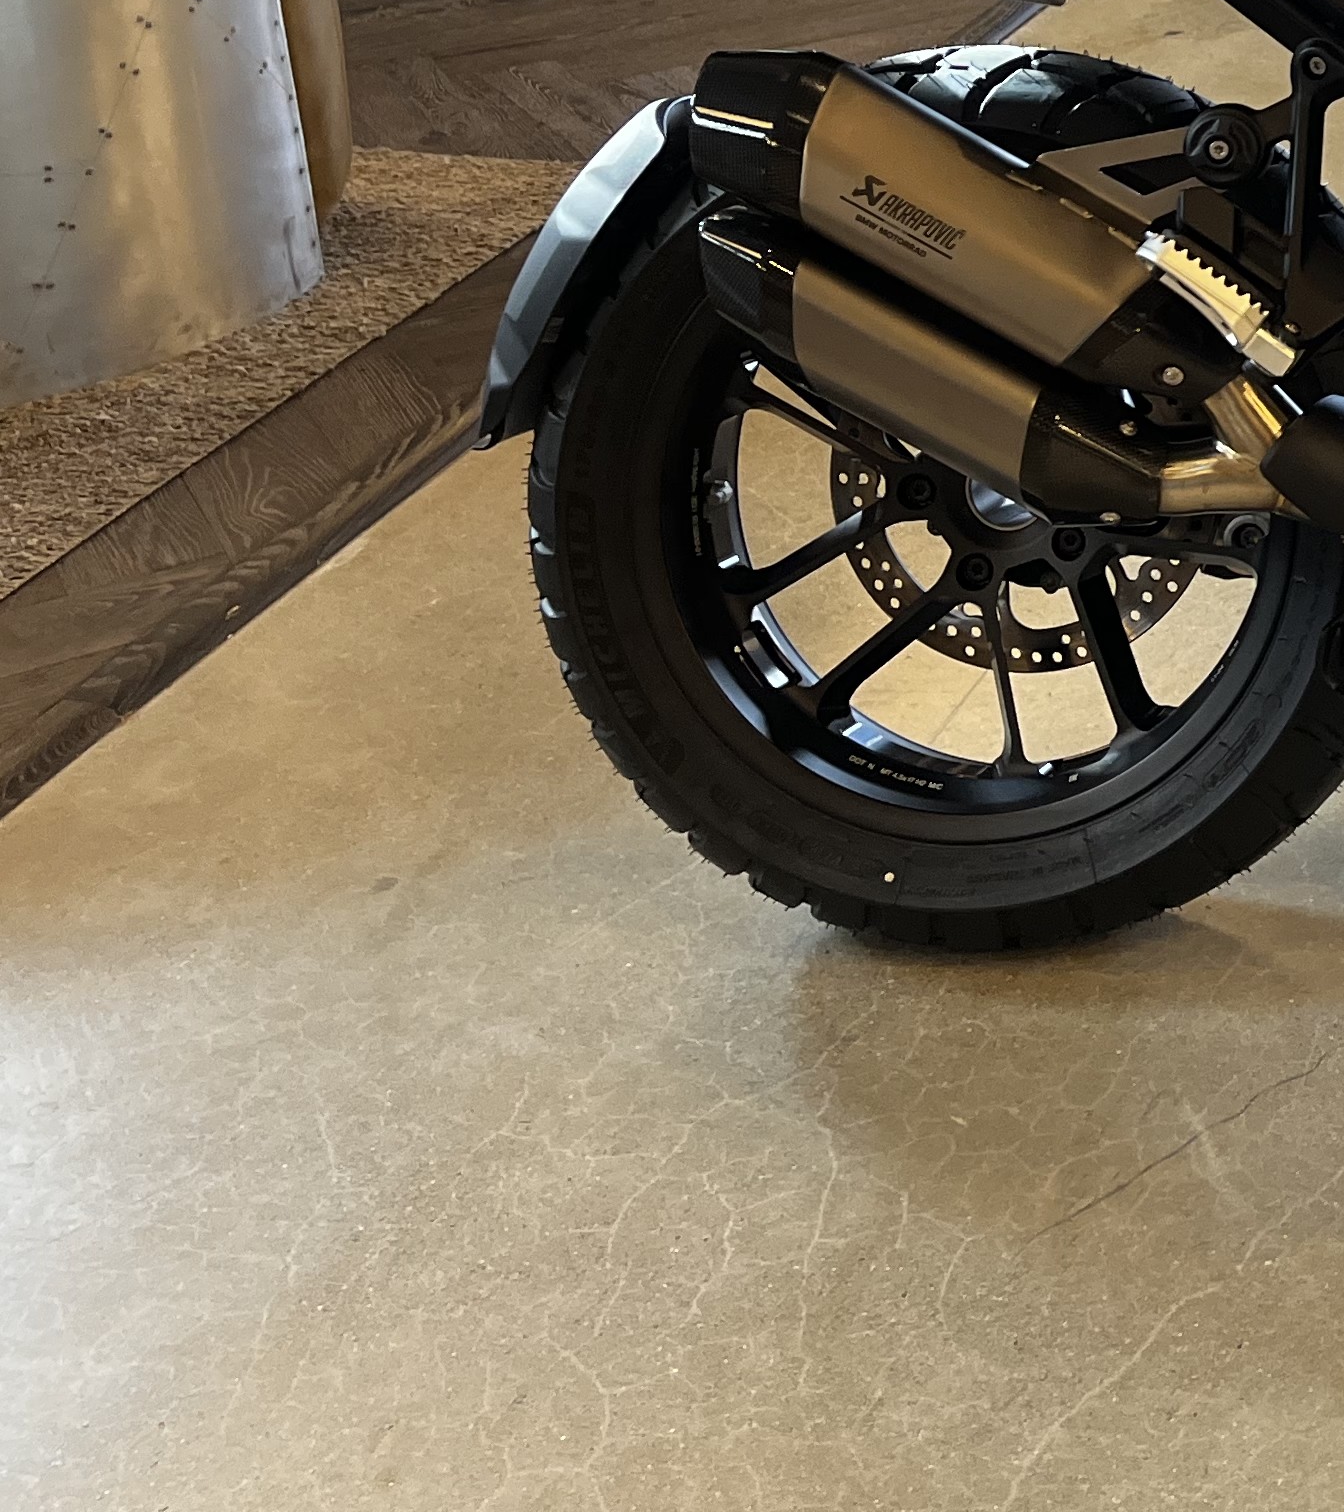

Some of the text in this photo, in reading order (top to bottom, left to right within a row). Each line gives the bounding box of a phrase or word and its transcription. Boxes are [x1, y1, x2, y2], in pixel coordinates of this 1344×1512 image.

[855, 213, 928, 258] BMW MOTORRAD
[848, 754, 868, 766] DOT
